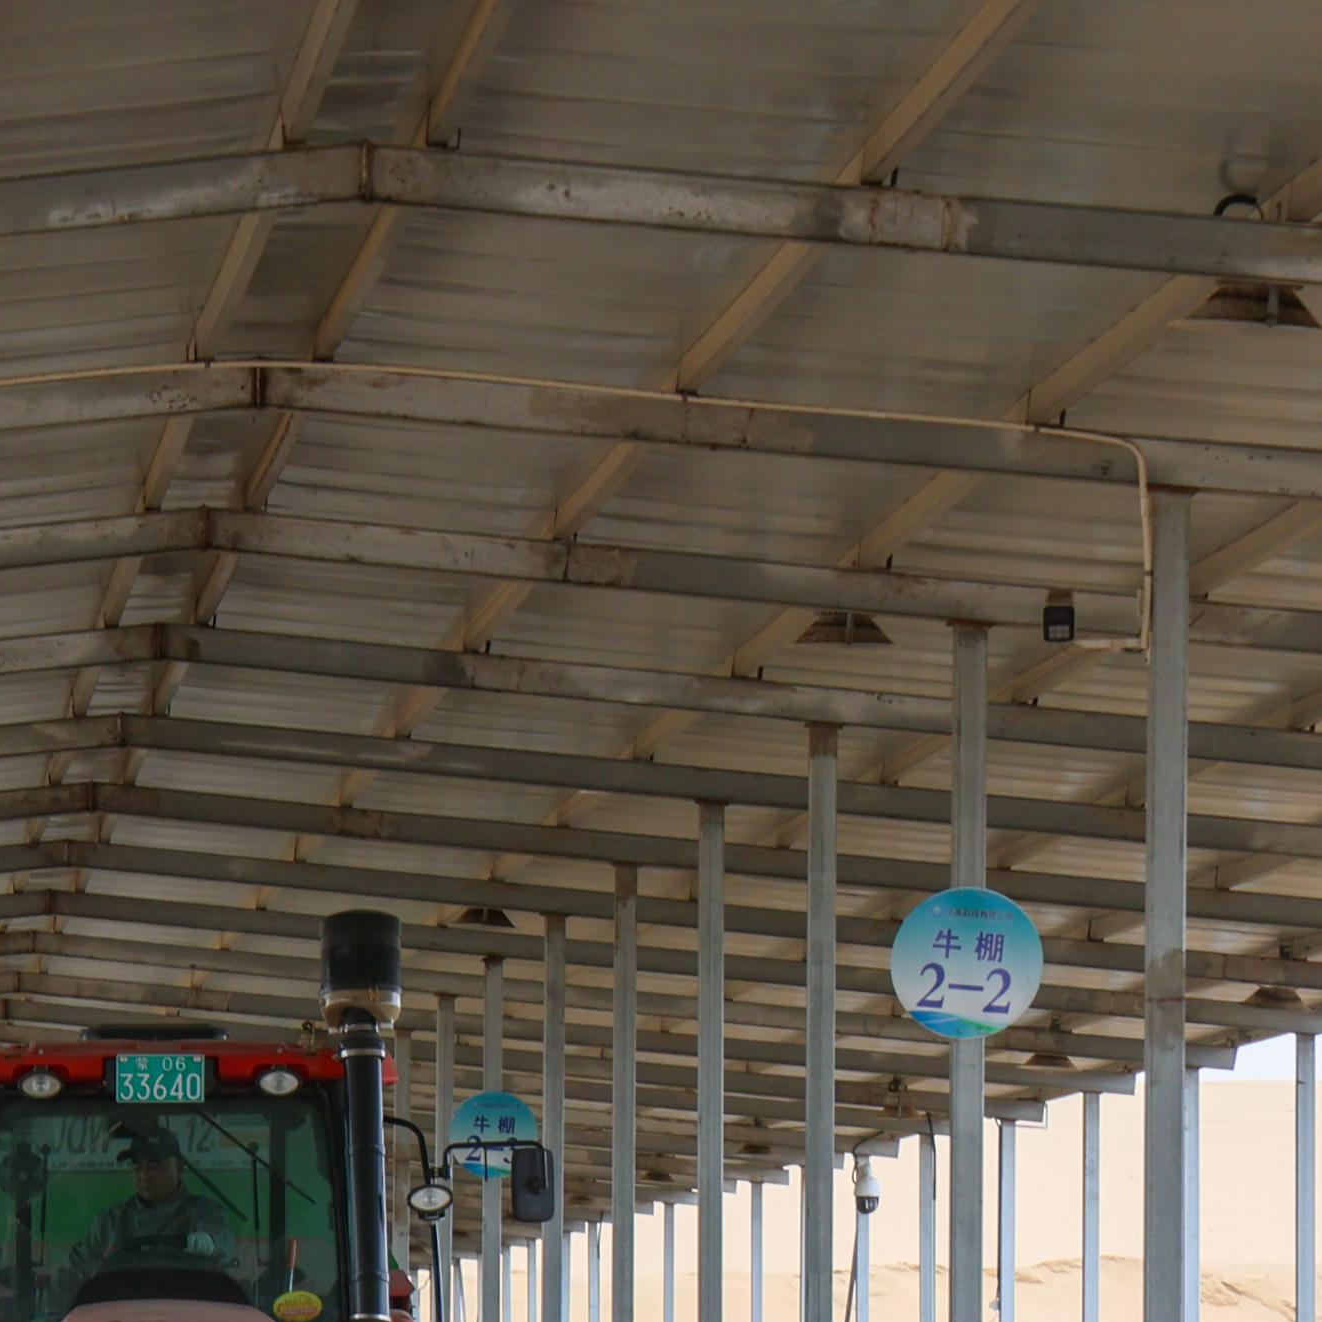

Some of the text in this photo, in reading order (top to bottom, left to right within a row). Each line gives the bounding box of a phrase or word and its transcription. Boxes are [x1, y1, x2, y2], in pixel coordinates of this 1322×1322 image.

[932, 928, 1005, 963] 牛棚
[162, 1057, 186, 1071] 06
[119, 1073, 201, 1100] 33640
[474, 1115, 515, 1134] 牛棚
